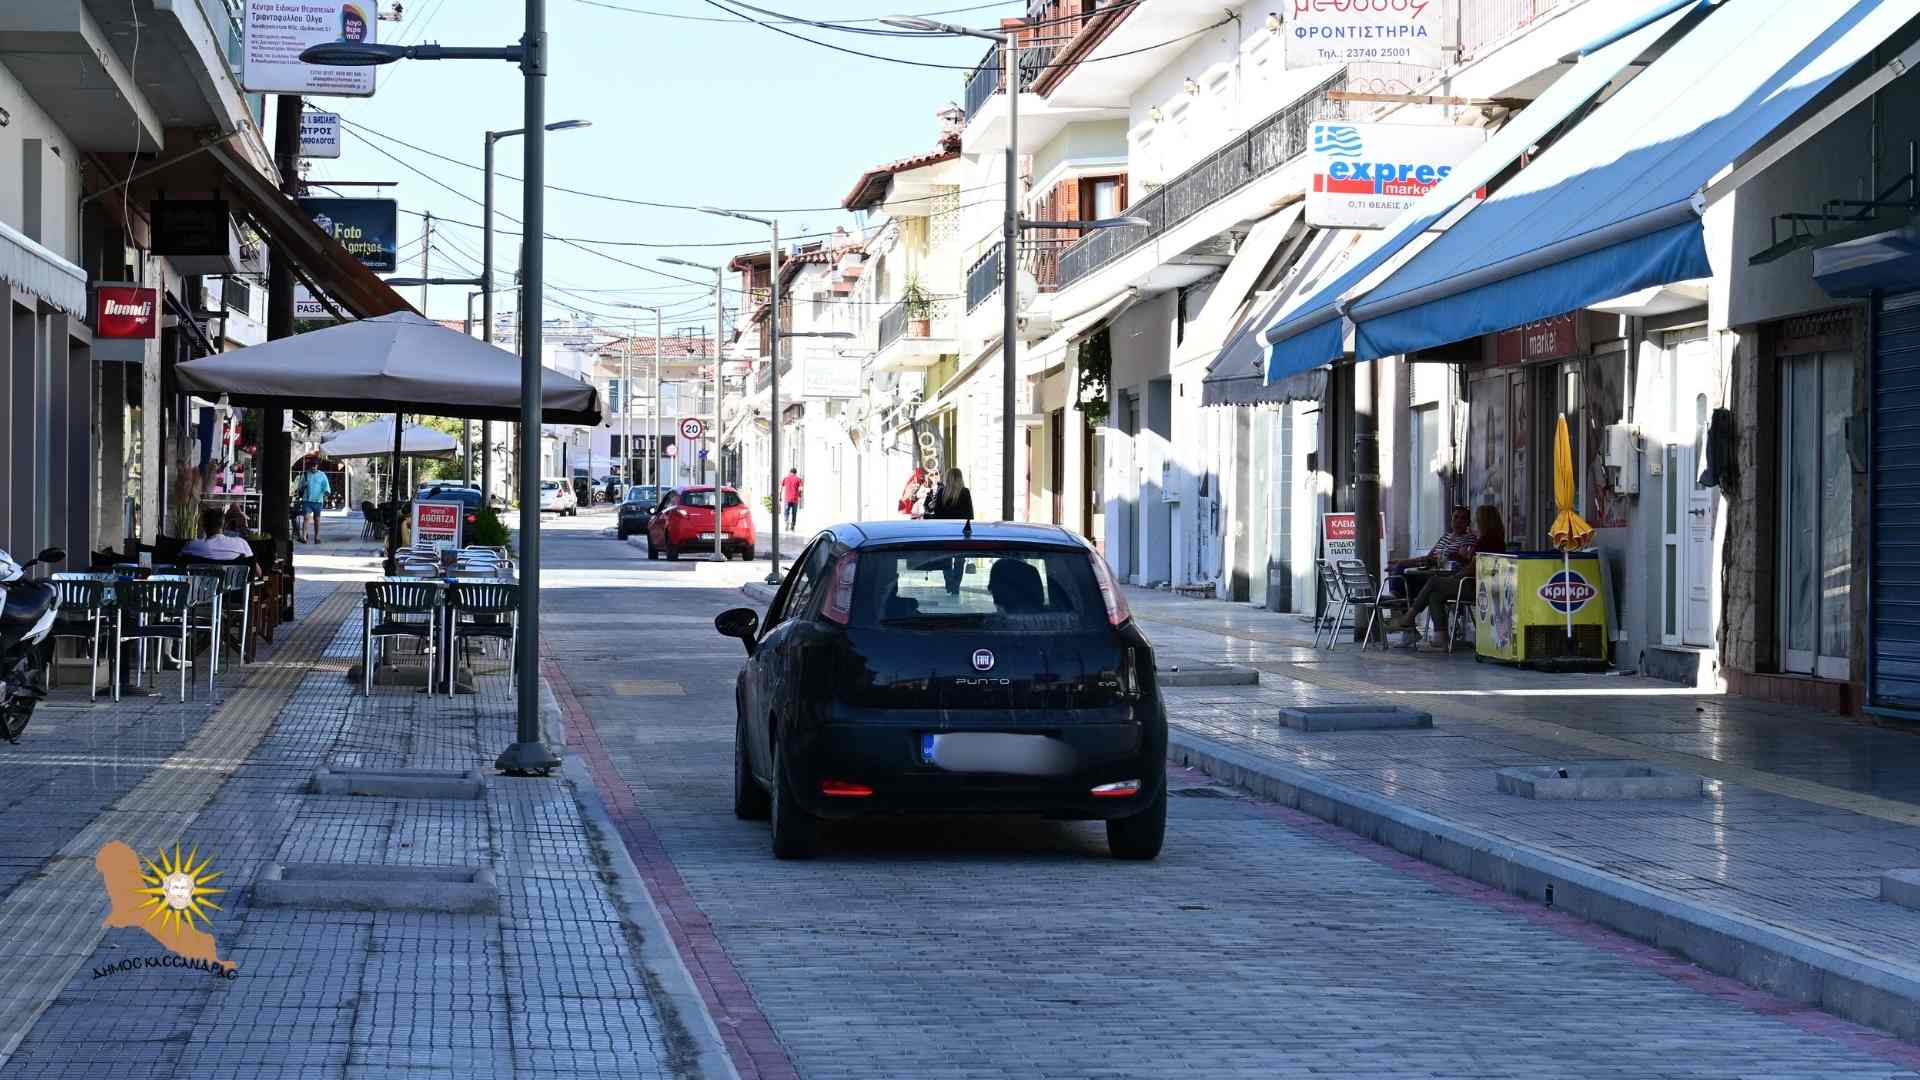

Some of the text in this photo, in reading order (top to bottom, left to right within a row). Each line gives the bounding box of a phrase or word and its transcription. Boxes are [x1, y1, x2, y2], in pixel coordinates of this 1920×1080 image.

[1295, 25, 1428, 39] ΦΡΟΝΤΙΣΤΗΡΙΑ
[1346, 48, 1378, 58] 23740
[1380, 48, 1411, 57] 25001
[334, 222, 362, 239] Foto
[1529, 327, 1558, 357] market
[685, 425, 698, 434] 20
[1331, 520, 1356, 528] ΚΛΕΙΔ
